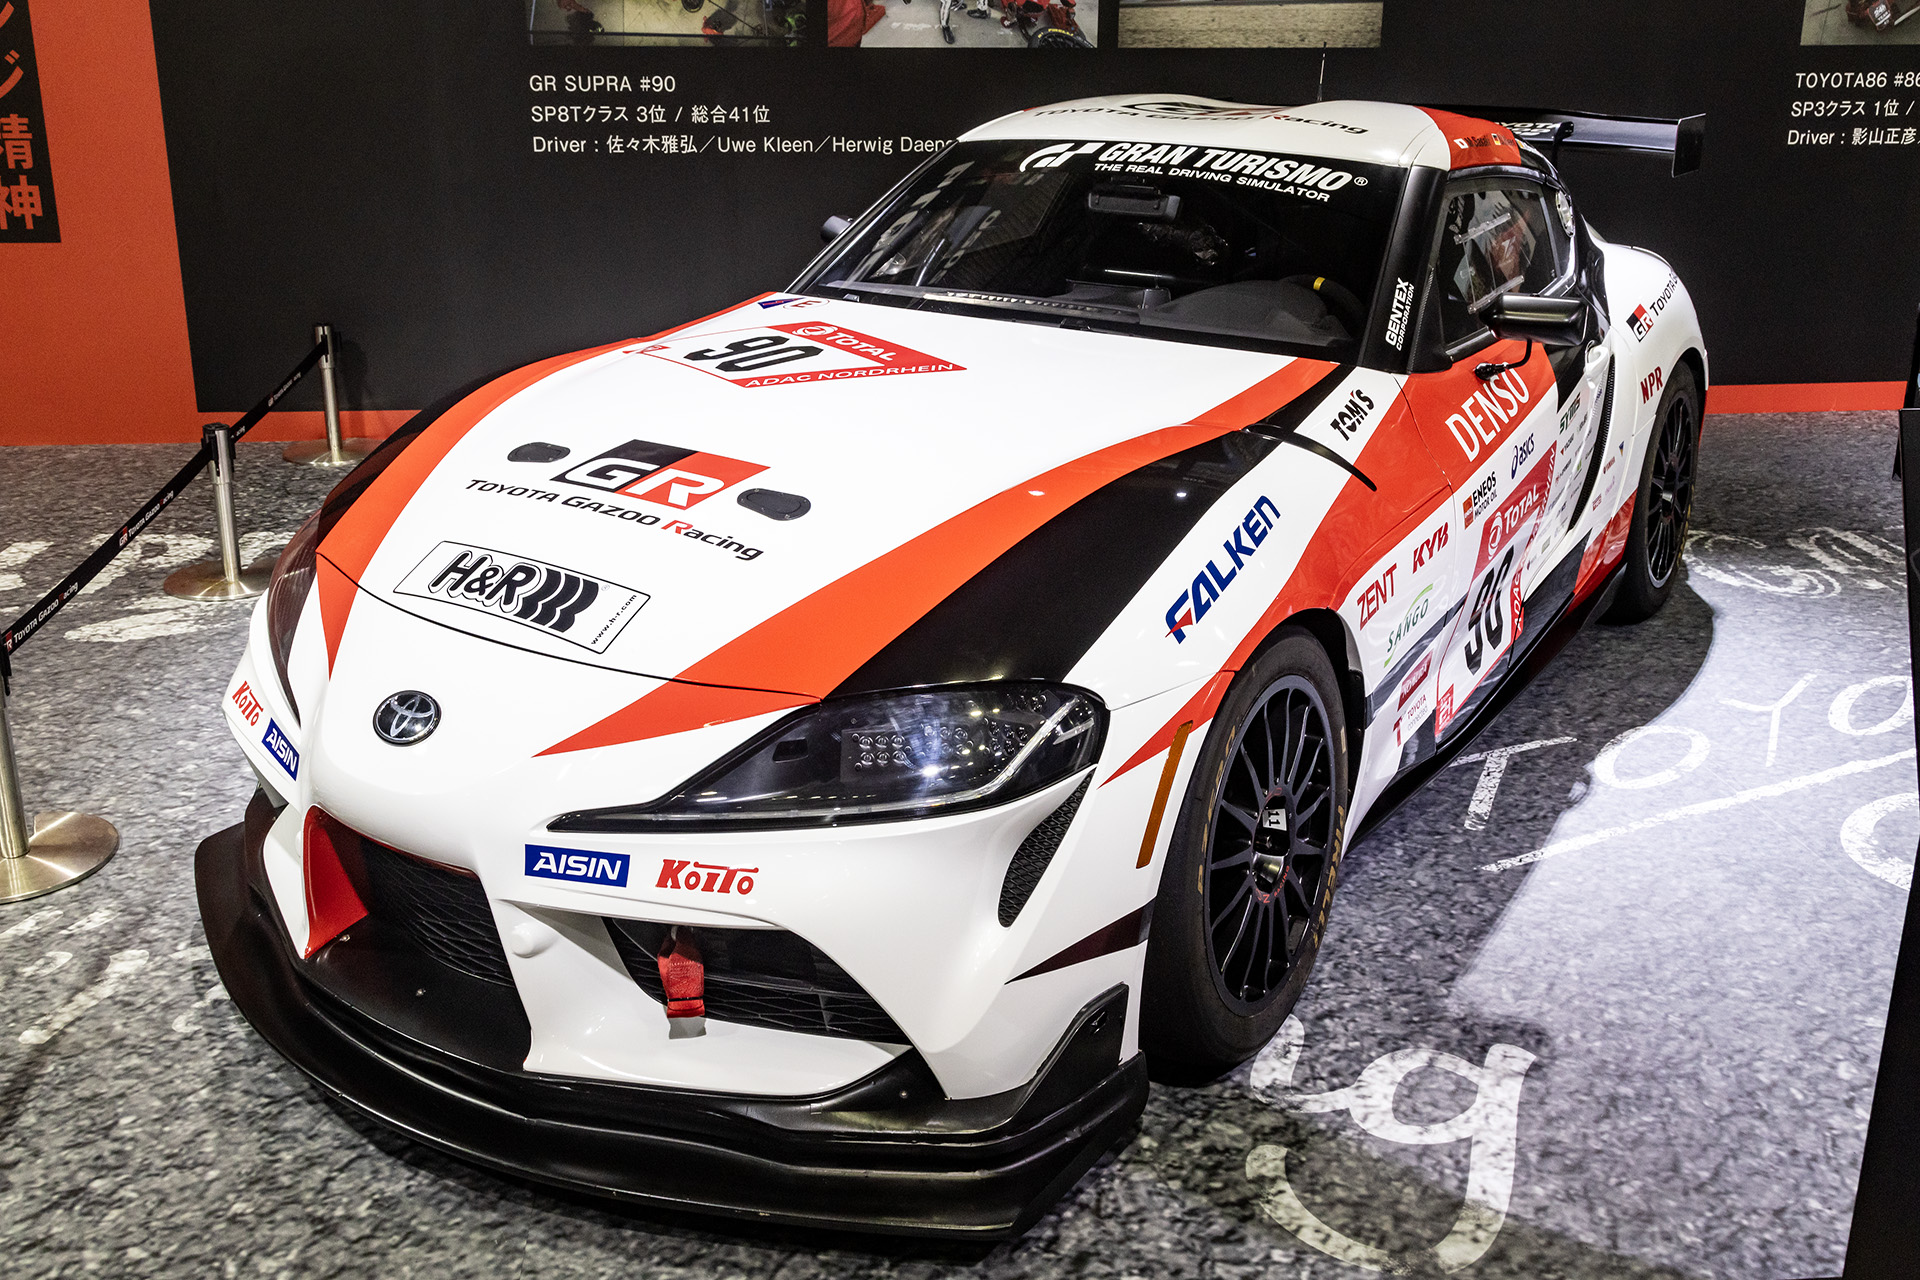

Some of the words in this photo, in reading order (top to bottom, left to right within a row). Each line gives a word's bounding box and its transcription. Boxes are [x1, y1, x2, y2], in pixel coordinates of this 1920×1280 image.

[529, 75, 557, 92] GR
[564, 75, 632, 92] SUPRA
[640, 75, 676, 92] #90
[1796, 72, 1888, 88] TOYOTA86
[531, 105, 629, 123] SP8Tクラス
[636, 105, 667, 123] 3位
[691, 105, 770, 124] 総合41位
[1260, 115, 1370, 135] Racing
[1791, 100, 1866, 117] SP3クラス
[1874, 99, 1900, 117] 1位
[533, 136, 587, 153] Driver
[1787, 130, 1835, 145] Driver
[1094, 162, 1124, 173] THE
[1125, 165, 1167, 176] REAL
[1167, 167, 1233, 184] DRIVING
[1235, 177, 1331, 203] SIMULATOR
[1097, 142, 1201, 167] GRAN
[1196, 148, 1354, 192] TURISMO
[1385, 277, 1409, 346] GENTEX
[1395, 283, 1415, 351] CORPORATION
[1649, 280, 1677, 316] TOYOTA
[827, 332, 897, 362] TOTAL
[1632, 312, 1654, 342] GR
[683, 335, 825, 373] 90
[745, 373, 813, 388] ADAC
[817, 364, 955, 380] NORDRHEIN
[1640, 366, 1663, 404] NPR
[1330, 389, 1375, 441] TOM'S
[1444, 363, 1530, 462] DENSO
[563, 457, 726, 508] GR
[1472, 471, 1497, 507] ENEOS
[465, 479, 560, 503] TOYOTA
[561, 495, 661, 526] GAZOO
[661, 519, 765, 561] Racing
[1504, 484, 1540, 535] TOTAL
[1165, 495, 1281, 644] FALKEN
[1412, 521, 1449, 574] KYB
[429, 551, 538, 608] H&R
[1356, 562, 1398, 631] ZENT
[13, 618, 38, 643] TOYOTA
[38, 599, 59, 622] GAZOO
[59, 582, 79, 603] Racing
[590, 594, 637, 646] www.h-r.com
[1387, 598, 1429, 653] SANGO
[1464, 545, 1515, 676] 90
[1407, 694, 1427, 719] TOYOTA
[265, 727, 298, 773] AISIN
[532, 851, 622, 881] AISIN
[1312, 804, 1346, 949] PIRELLI
